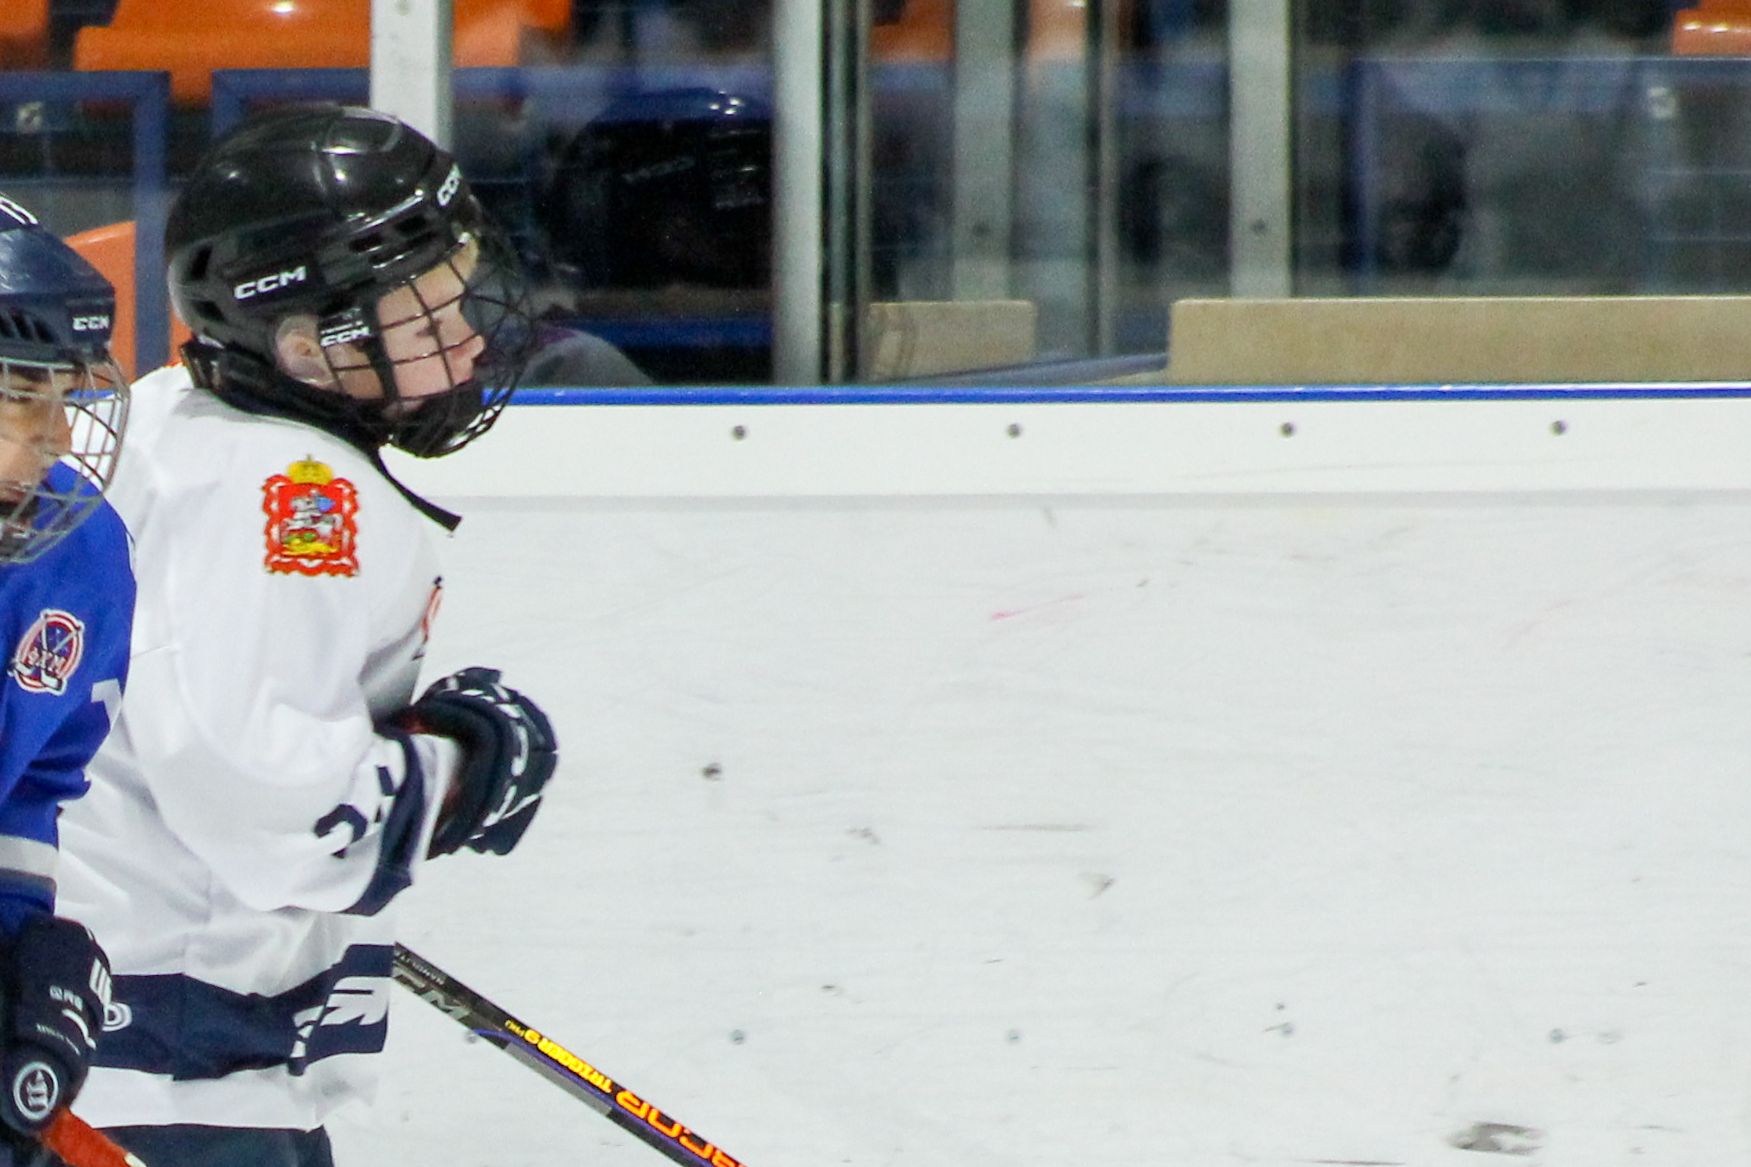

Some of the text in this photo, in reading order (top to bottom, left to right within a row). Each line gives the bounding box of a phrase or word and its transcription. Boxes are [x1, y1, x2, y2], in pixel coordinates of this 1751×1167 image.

[234, 265, 308, 300] CCM
[320, 326, 374, 349] CCM
[536, 1036, 613, 1093] TRIGGER
